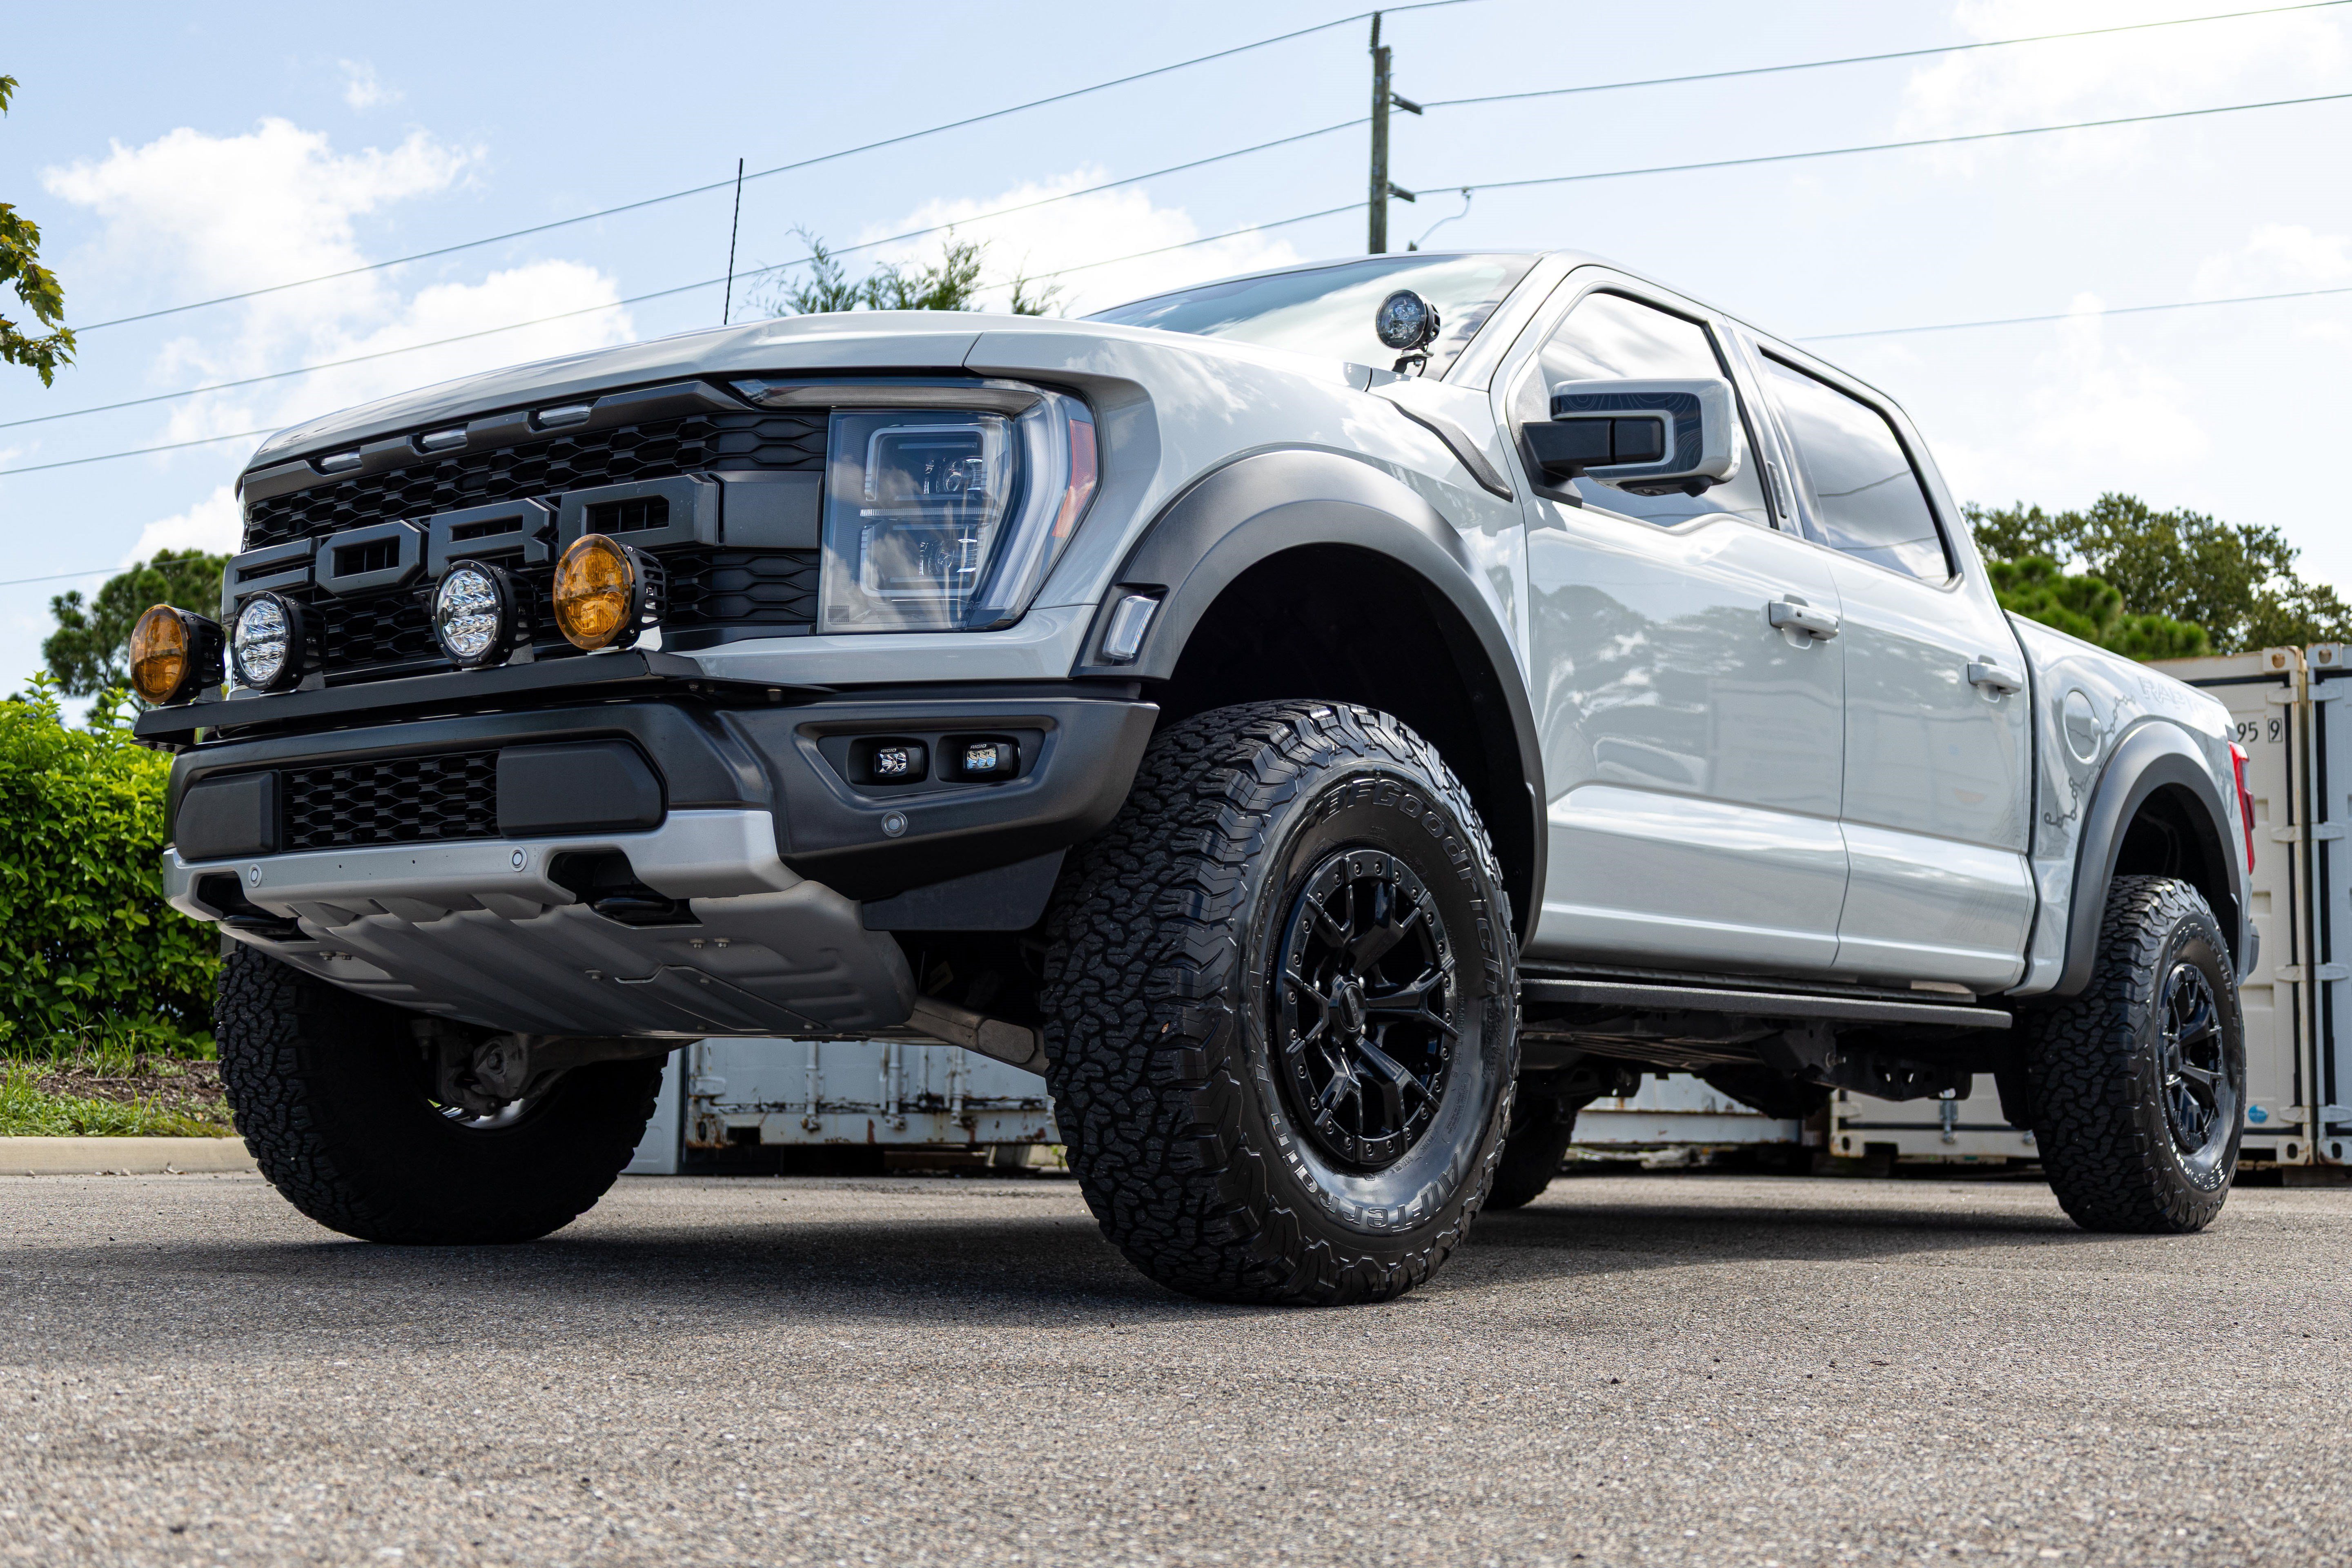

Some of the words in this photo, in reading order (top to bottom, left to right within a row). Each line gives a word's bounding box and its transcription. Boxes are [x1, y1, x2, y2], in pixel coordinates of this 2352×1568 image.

[222, 474, 716, 625] FORD
[2237, 722, 2258, 743] 95
[2270, 720, 2280, 741] 9
[1322, 778, 1501, 994] BFGoodrich
[1270, 1113, 1459, 1233] All-Terrain
